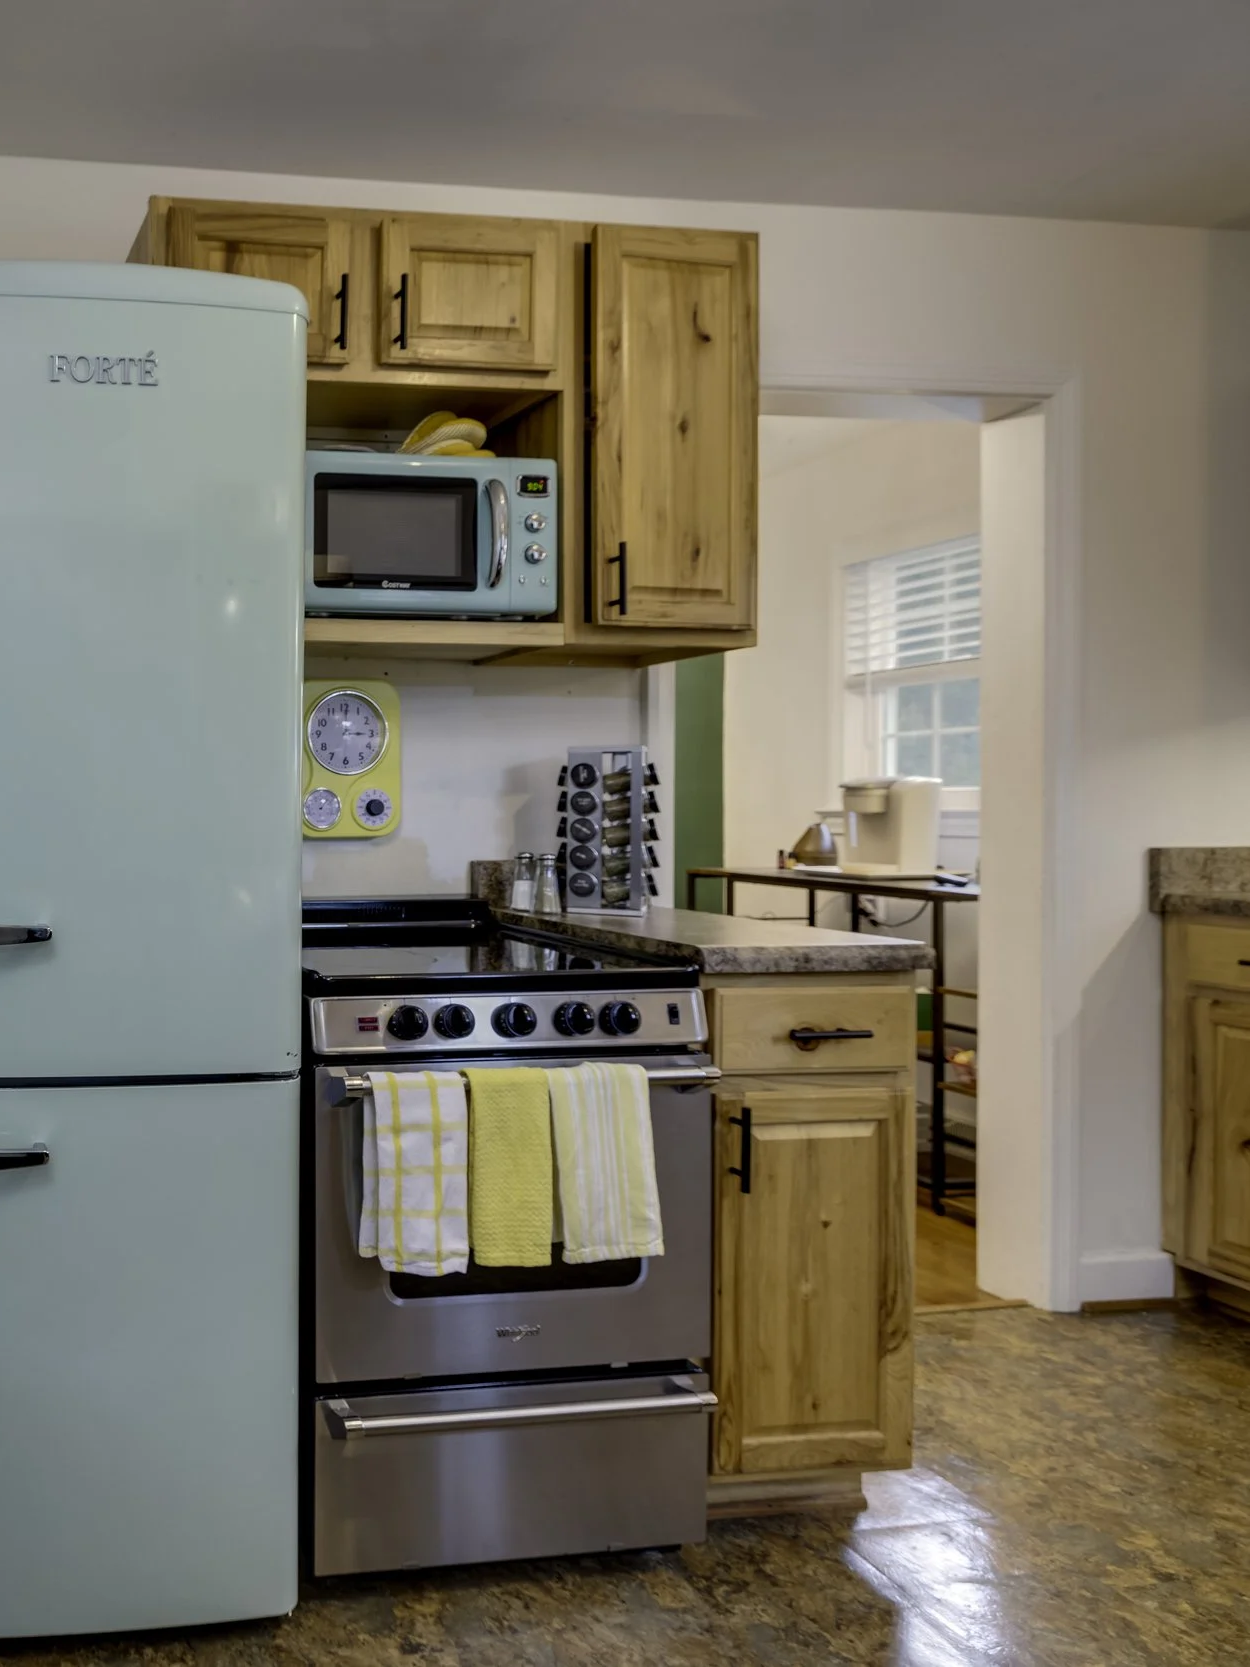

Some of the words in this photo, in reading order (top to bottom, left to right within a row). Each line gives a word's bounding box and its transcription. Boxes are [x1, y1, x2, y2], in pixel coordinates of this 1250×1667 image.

[49, 350, 158, 386] FORTÉ
[327, 707, 335, 716] 11
[317, 718, 327, 727] 10
[363, 716, 370, 725] 2
[315, 729, 322, 738] 9
[368, 729, 375, 738] 3
[320, 742, 327, 751] 8
[365, 742, 372, 750] 4
[328, 751, 335, 761] 7
[342, 756, 349, 765] 6
[358, 751, 365, 761] 5
